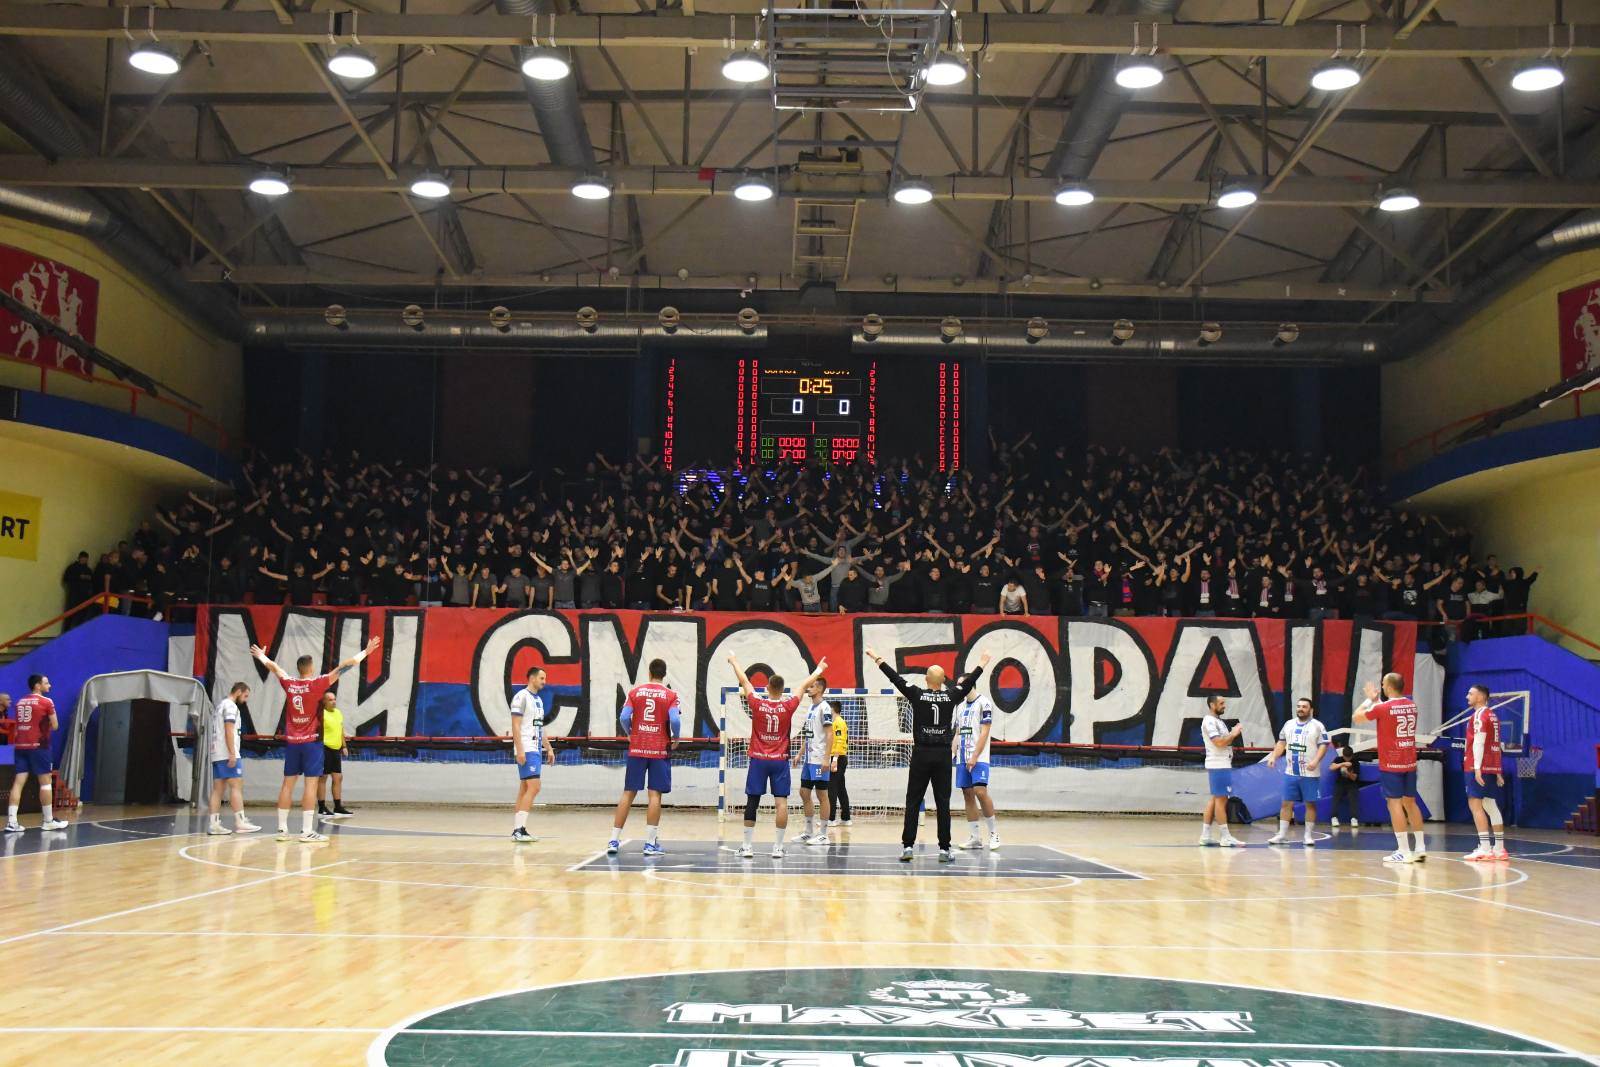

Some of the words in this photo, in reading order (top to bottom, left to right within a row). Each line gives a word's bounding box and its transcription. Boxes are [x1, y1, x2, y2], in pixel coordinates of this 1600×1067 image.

[800, 379, 833, 394] 0:25
[793, 399, 804, 414] 0
[839, 399, 850, 415] 0
[208, 607, 424, 738] МИ
[472, 609, 820, 742] СМО
[292, 695, 305, 714] 9
[643, 698, 656, 721] 2
[931, 704, 940, 725] 1
[765, 714, 780, 733] 11
[1396, 714, 1416, 738] 22
[662, 1002, 1256, 1033] MAXBET
